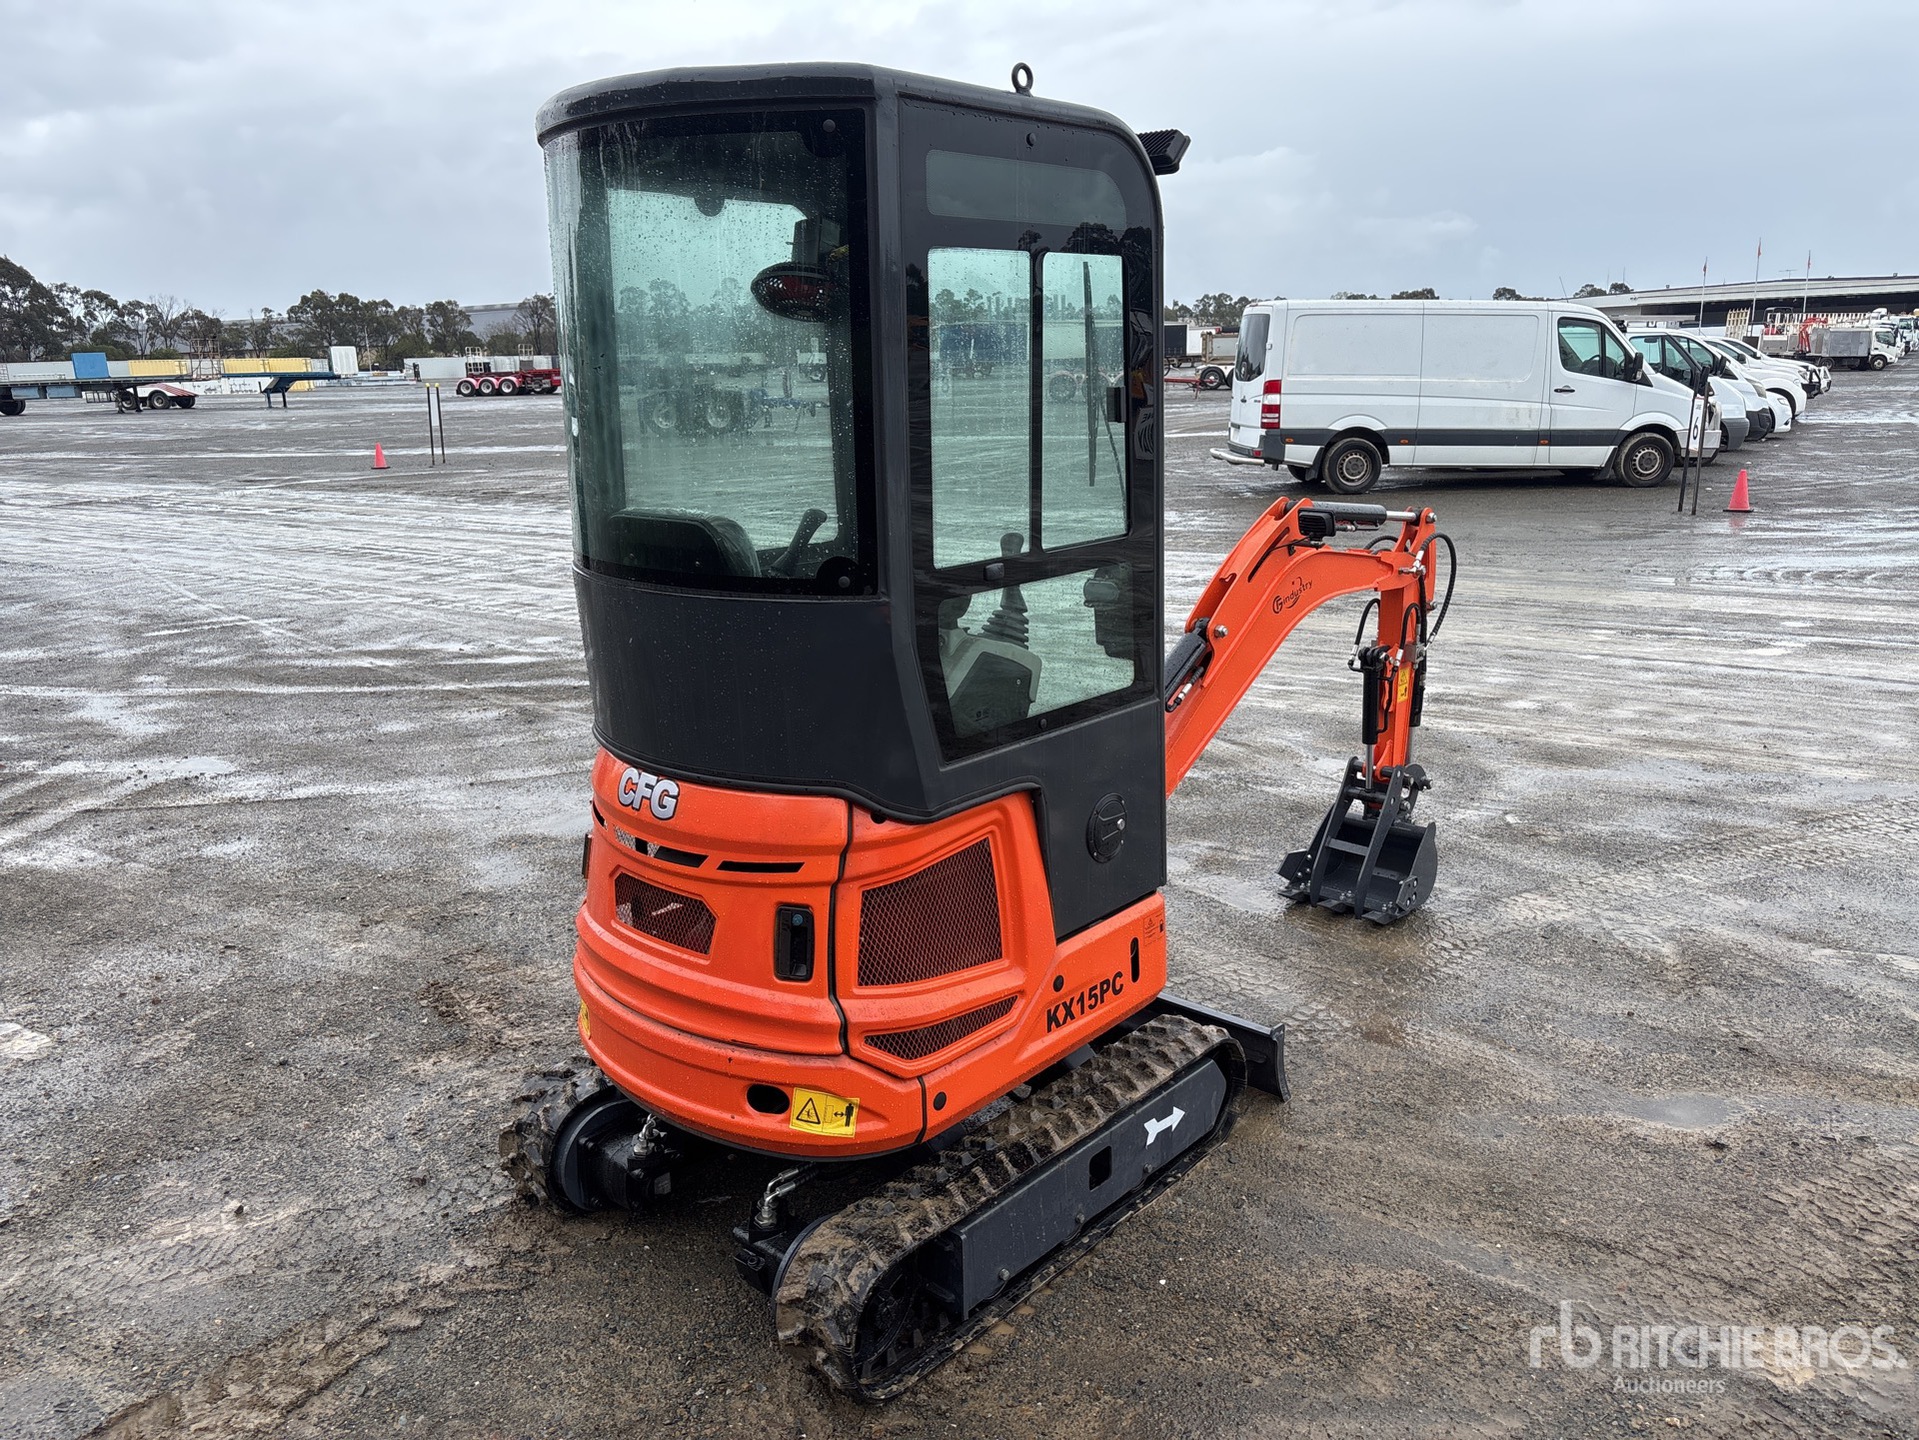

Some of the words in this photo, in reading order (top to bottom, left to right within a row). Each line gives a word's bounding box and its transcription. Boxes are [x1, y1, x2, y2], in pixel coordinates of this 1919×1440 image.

[1692, 416, 1699, 440] 6
[618, 767, 679, 820] CFG
[1046, 971, 1124, 1033] KX15PC
